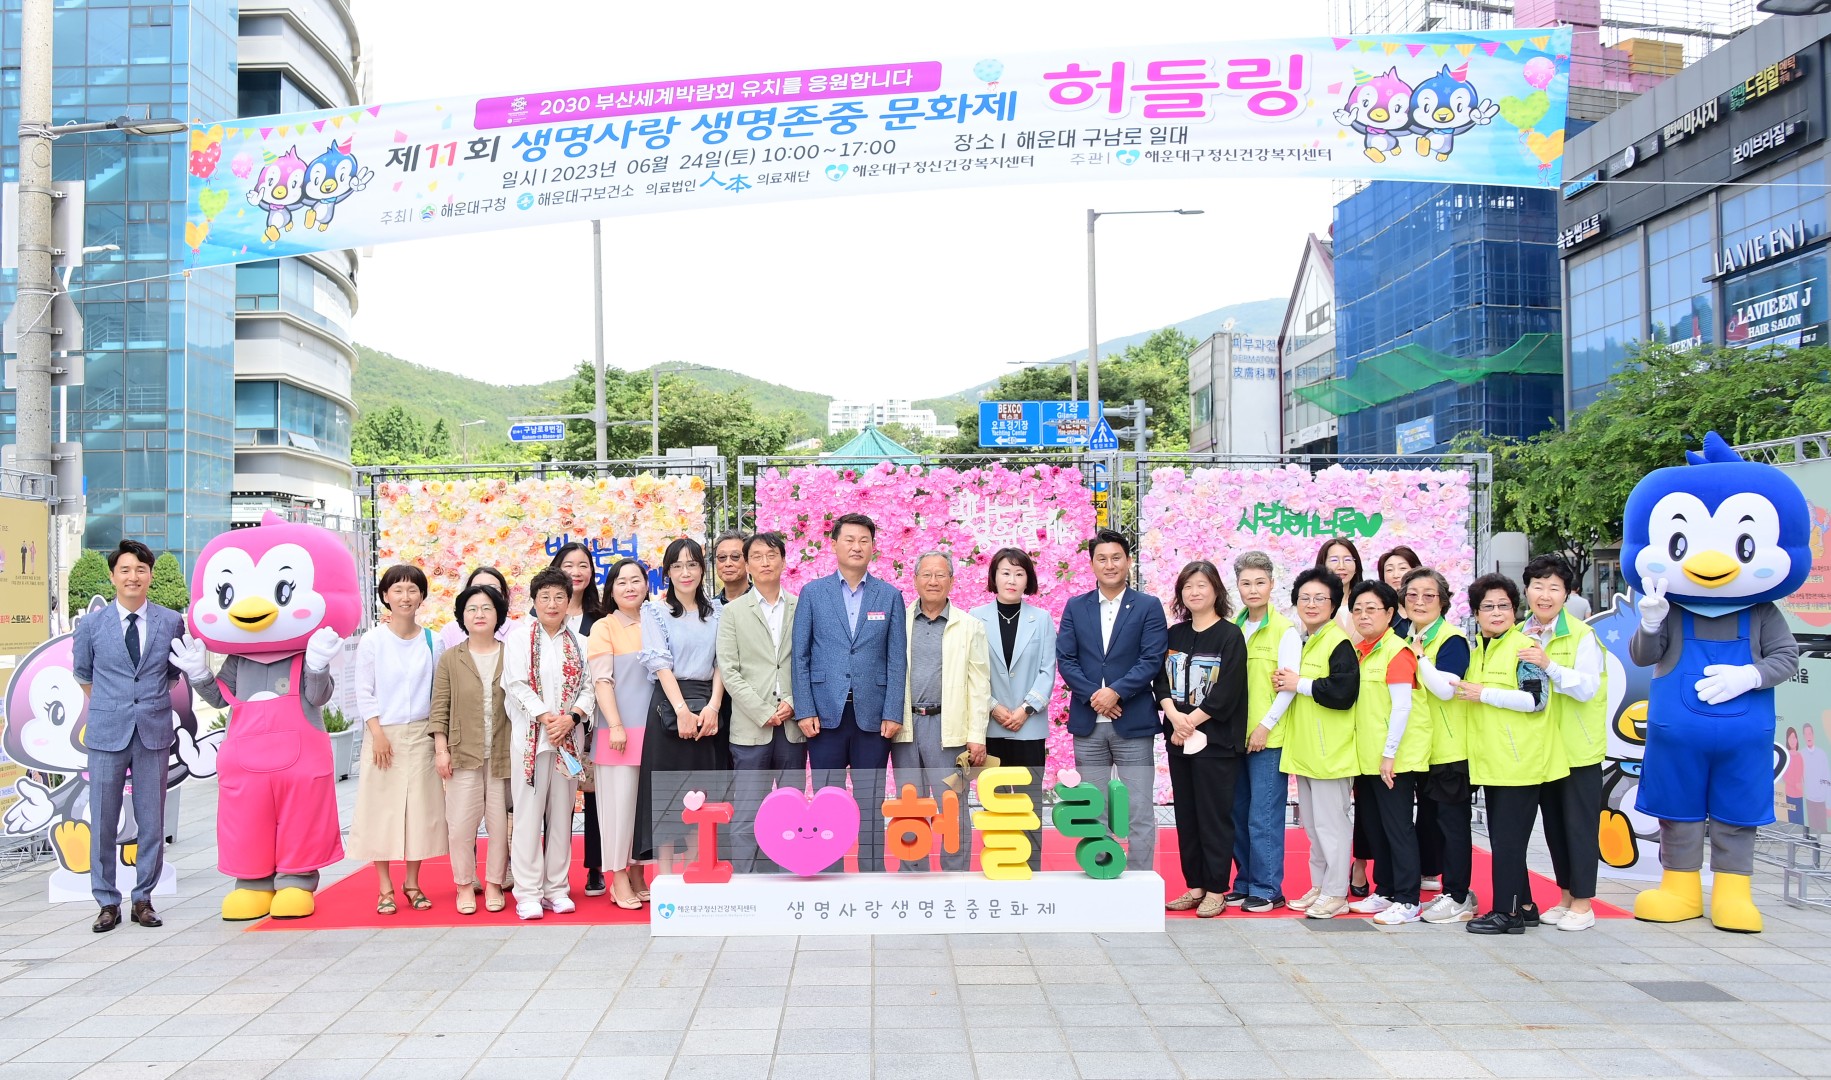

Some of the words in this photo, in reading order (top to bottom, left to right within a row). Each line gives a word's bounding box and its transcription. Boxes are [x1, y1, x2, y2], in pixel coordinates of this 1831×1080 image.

[540, 97, 591, 116] 2030
[595, 82, 735, 112] 부산세계박람회
[741, 76, 802, 99] 유치를
[808, 69, 914, 93] 응원합니다
[1745, 62, 1780, 100] 드림힐
[384, 135, 500, 175] 제11회
[511, 116, 681, 163] 생명사랑
[690, 100, 869, 147] 생명존중
[878, 91, 1018, 132] 문화제
[1043, 54, 1304, 118] 허들링
[1683, 97, 1718, 135] 마사지
[953, 132, 995, 152] 장소
[1016, 128, 1076, 151] 해운대
[1081, 127, 1143, 149] 구남로
[1149, 125, 1189, 146] 일대
[1732, 122, 1786, 165] 보이브라질
[501, 168, 538, 190] 일시
[551, 158, 617, 184] 2023년
[626, 154, 670, 176] 06월
[679, 147, 757, 172] 24일(토)
[756, 169, 811, 186] 의료재단
[852, 154, 1035, 179] 해운대구정신건강복지센터
[1070, 151, 1105, 166] 주관
[1144, 146, 1332, 164] 해운대구정신건강복지센터
[380, 209, 406, 227] 주최
[440, 195, 507, 218] 해운대구청
[537, 182, 635, 207] 해운대구보건소
[645, 178, 697, 196] 의료법인
[1557, 214, 1600, 249] 속눈썹프로
[1714, 247, 1736, 277] LA
[1736, 234, 1766, 267] VIE
[1769, 223, 1796, 257] EN
[1799, 219, 1807, 248] J
[1737, 291, 1799, 326] LAVIEEN
[1802, 287, 1812, 308] J
[1747, 322, 1770, 339] HAIR
[1771, 313, 1802, 332] SALON
[991, 420, 1028, 431] 요트경기장
[998, 403, 1022, 414] BEXCO
[1056, 402, 1079, 413] 기장
[1057, 412, 1077, 420] Gijang
[524, 425, 562, 435] 구남로8번길
[11, 614, 31, 624] 스트레스
[882, 766, 1130, 880] 허들링
[681, 802, 734, 883] I
[677, 904, 757, 914] 해운대구정신건강복지센터
